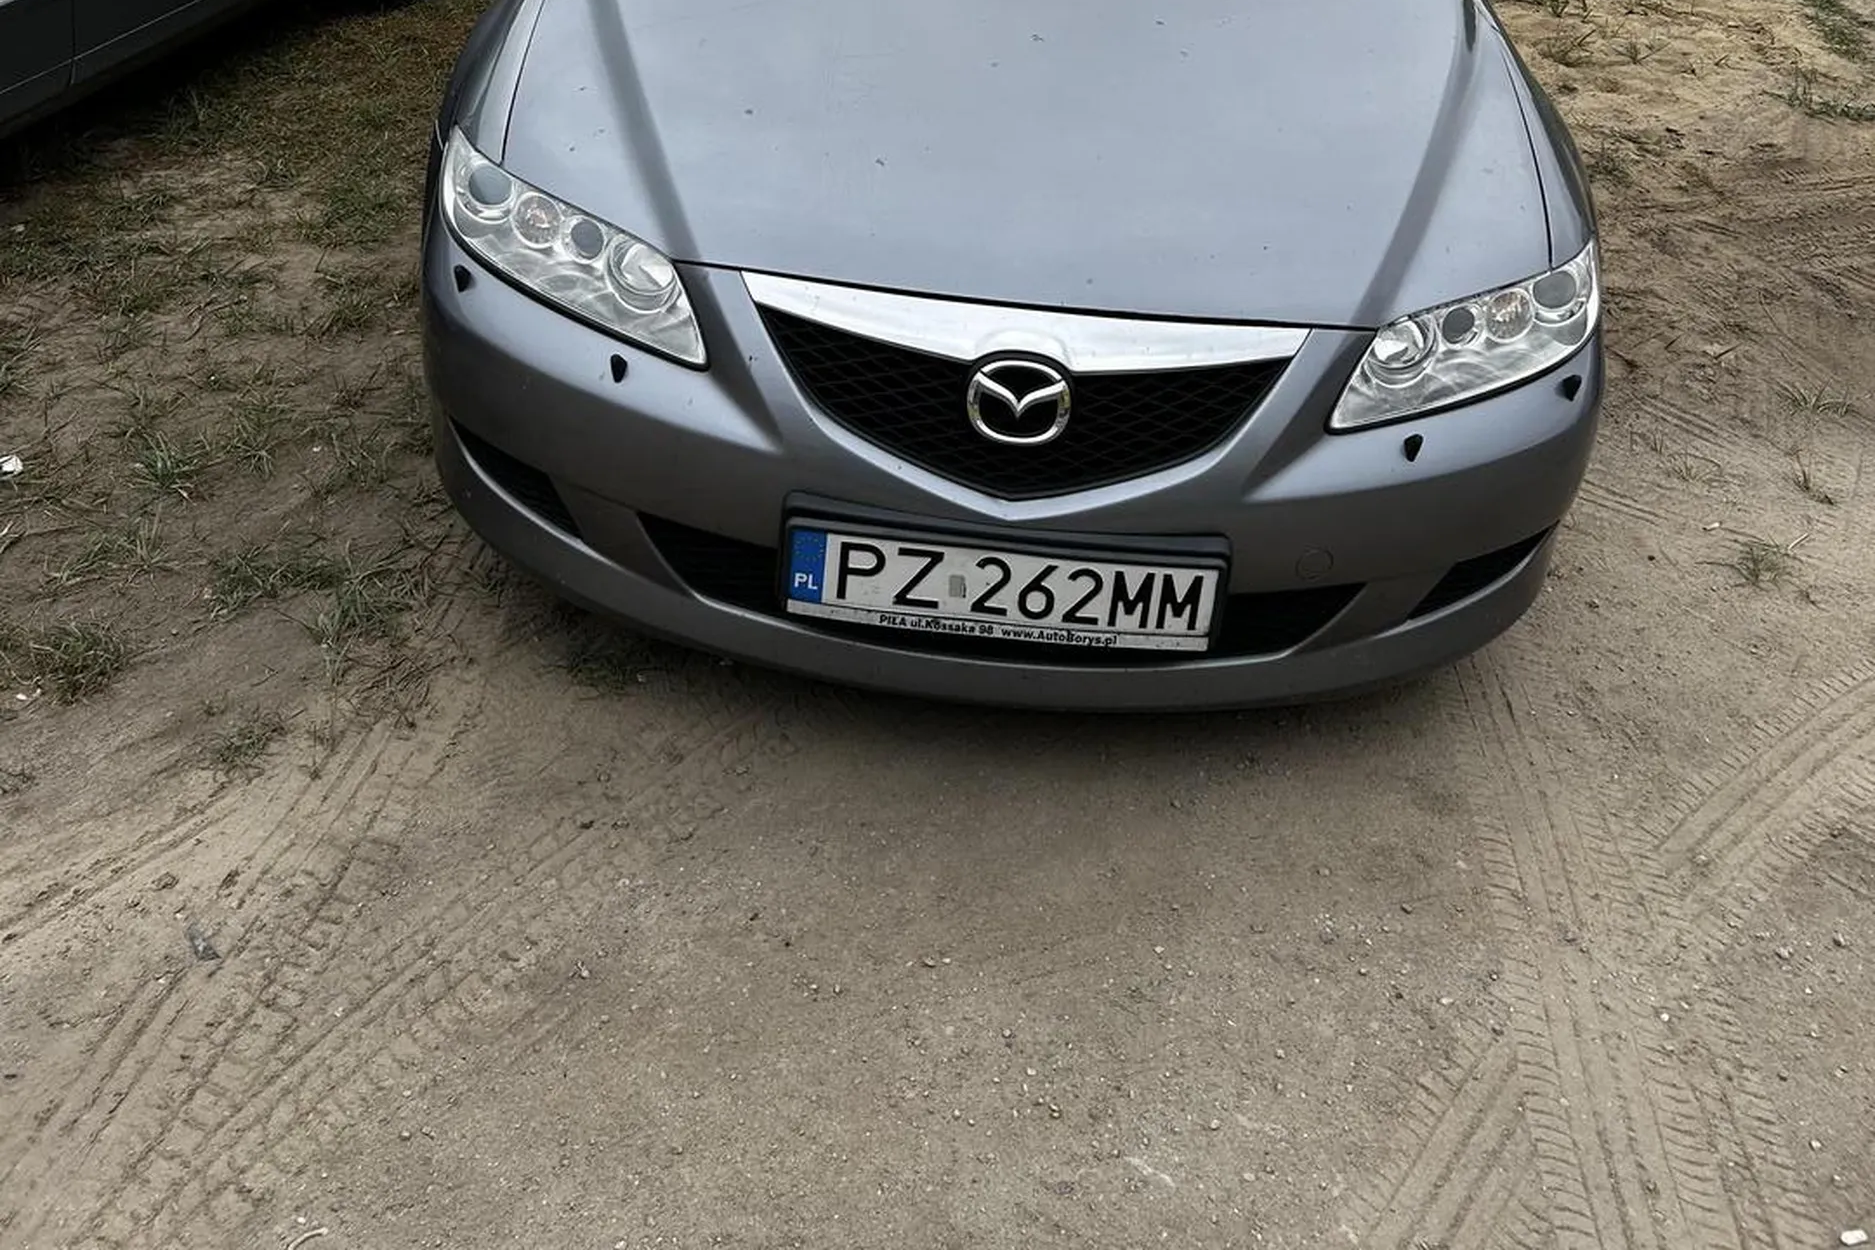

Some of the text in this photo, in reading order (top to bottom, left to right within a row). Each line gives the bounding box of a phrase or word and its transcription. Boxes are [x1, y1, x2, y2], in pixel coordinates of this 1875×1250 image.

[793, 572, 818, 590] PL
[836, 541, 1204, 631] PZ 262MM
[979, 624, 994, 635] 98
